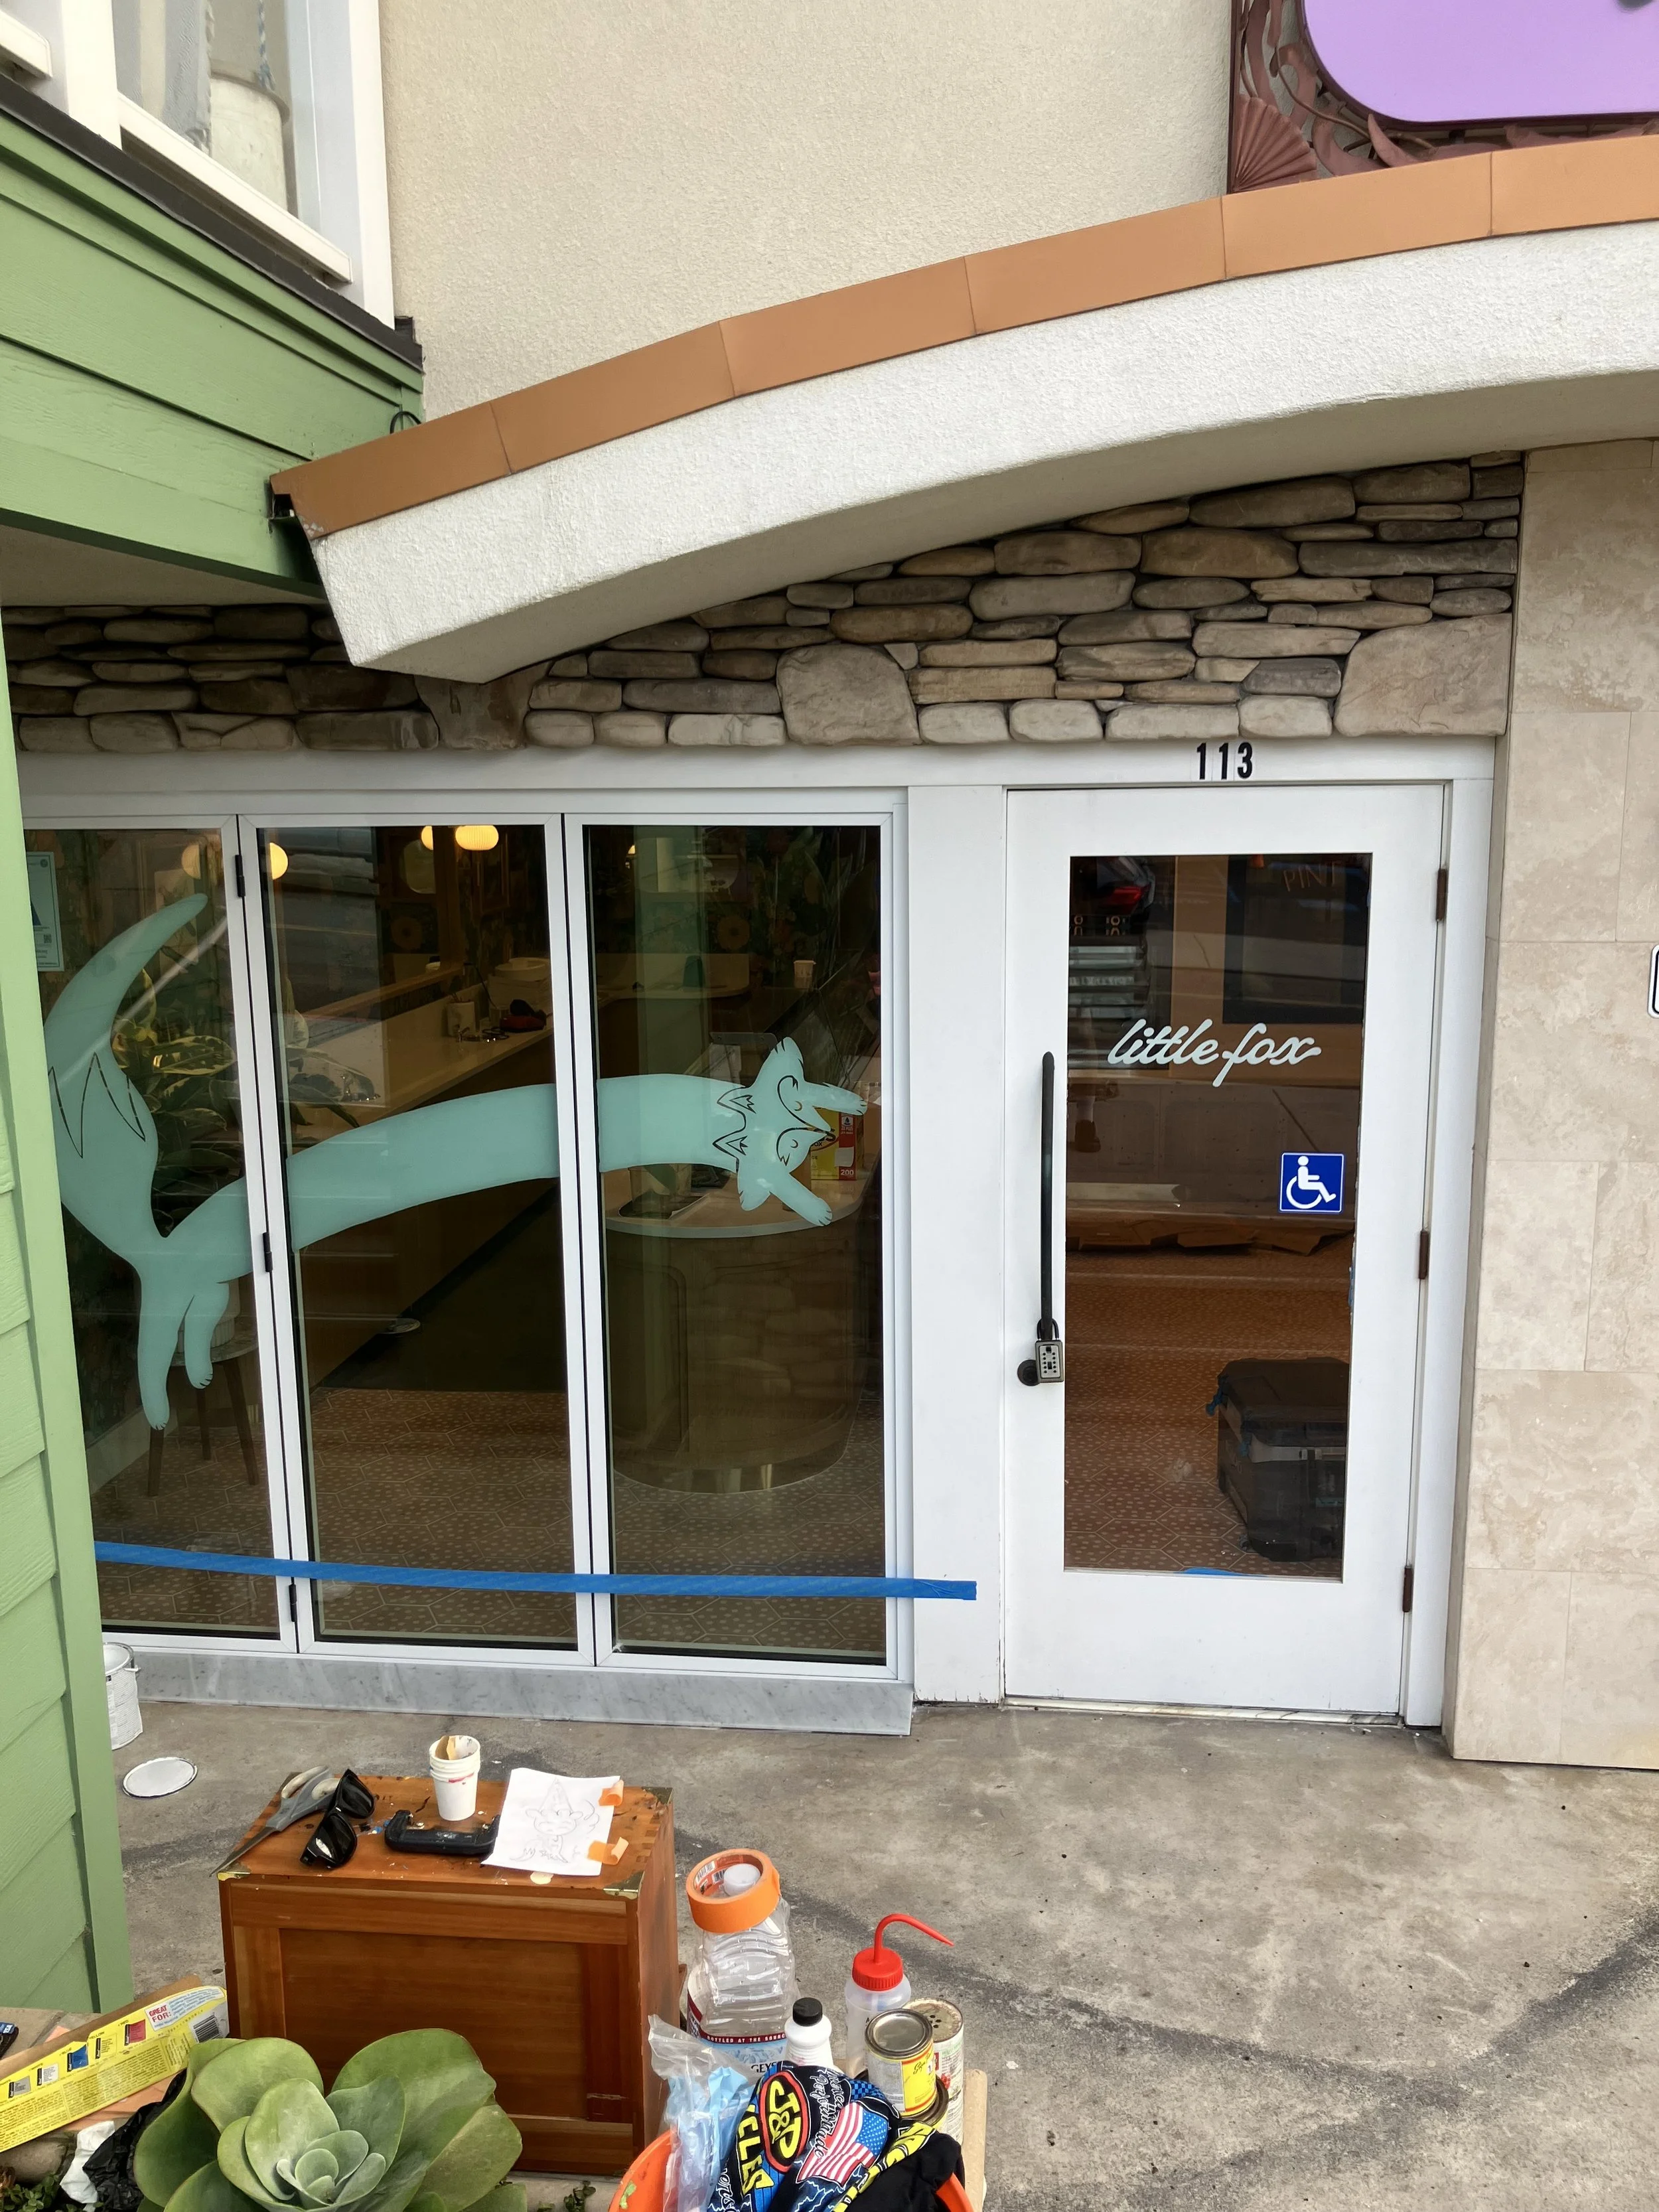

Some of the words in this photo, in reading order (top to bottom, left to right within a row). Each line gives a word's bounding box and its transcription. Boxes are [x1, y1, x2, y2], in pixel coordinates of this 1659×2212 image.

[1196, 741, 1254, 780] 113
[1107, 1019, 1220, 1066] little
[1213, 1022, 1321, 1087] fox
[149, 2004, 167, 2016] GREAT
[152, 2012, 172, 2023] FOR:
[768, 2080, 802, 2159] J&P
